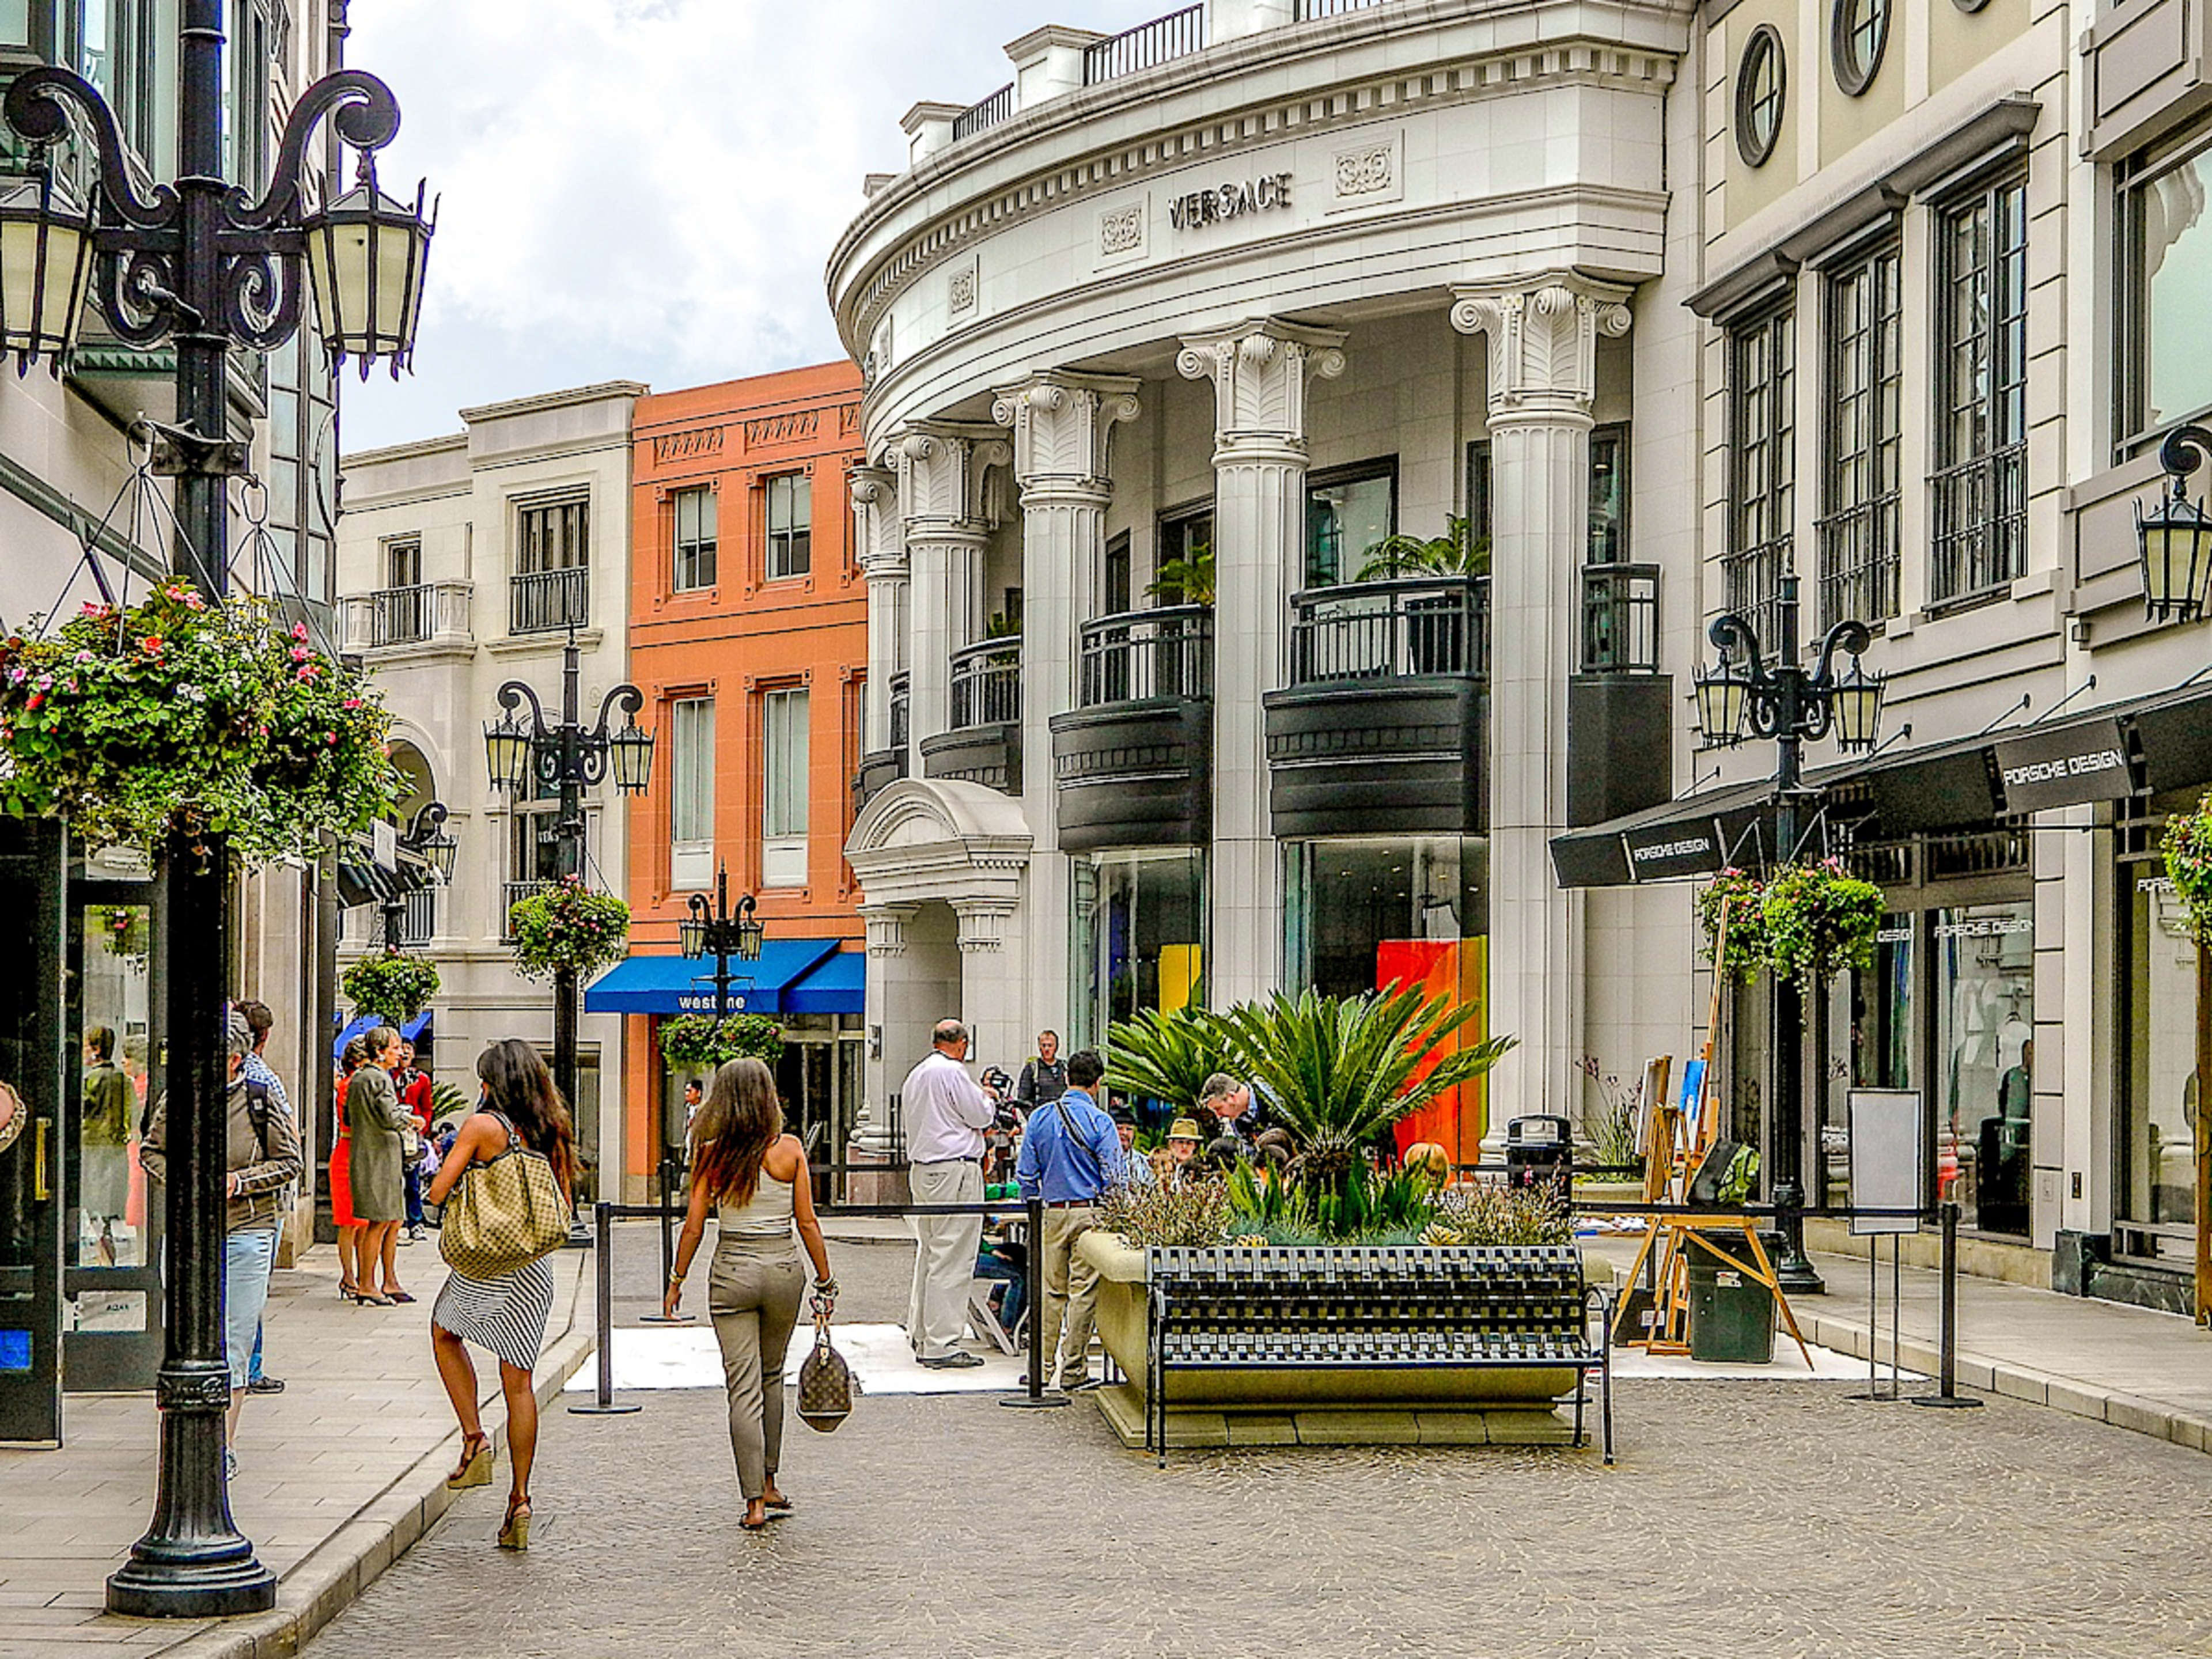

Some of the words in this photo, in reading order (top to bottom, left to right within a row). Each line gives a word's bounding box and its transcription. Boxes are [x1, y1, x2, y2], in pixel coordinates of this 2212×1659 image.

[1168, 172, 1293, 232] VERSACE
[2003, 759, 2067, 786] PORSCHE
[2068, 748, 2123, 776] DESIGN
[1634, 843, 1674, 862] PORSCHE
[1674, 837, 1710, 855] DESIGN
[1934, 922, 1990, 938] PORSCHE
